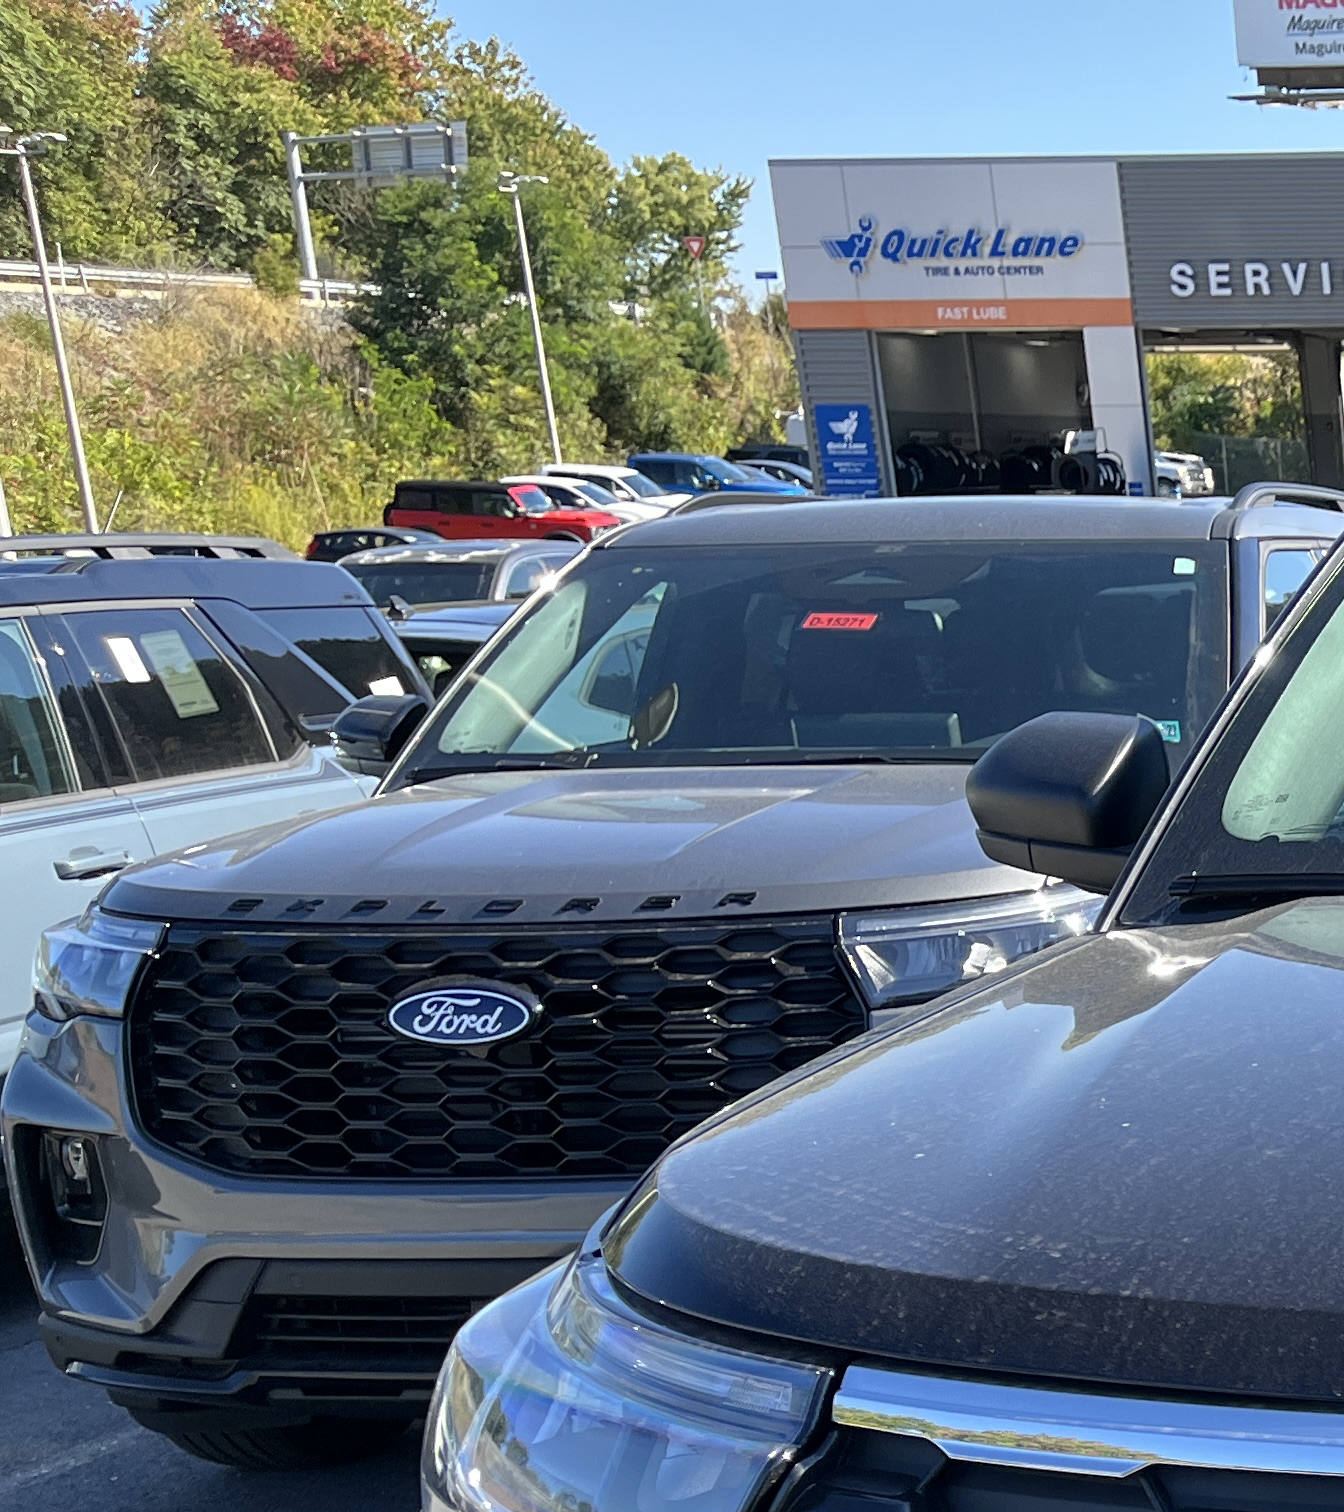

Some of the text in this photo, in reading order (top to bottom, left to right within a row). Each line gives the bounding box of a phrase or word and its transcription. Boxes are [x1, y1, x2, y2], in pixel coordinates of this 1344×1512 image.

[880, 228, 1080, 264] Quick Lane
[923, 266, 950, 277] TIRE
[963, 265, 995, 276] AUTO
[997, 265, 1044, 276] CENTER
[937, 306, 1007, 320] FAST LUBE
[226, 891, 758, 914] EXPLORER
[412, 996, 505, 1035] Ford
